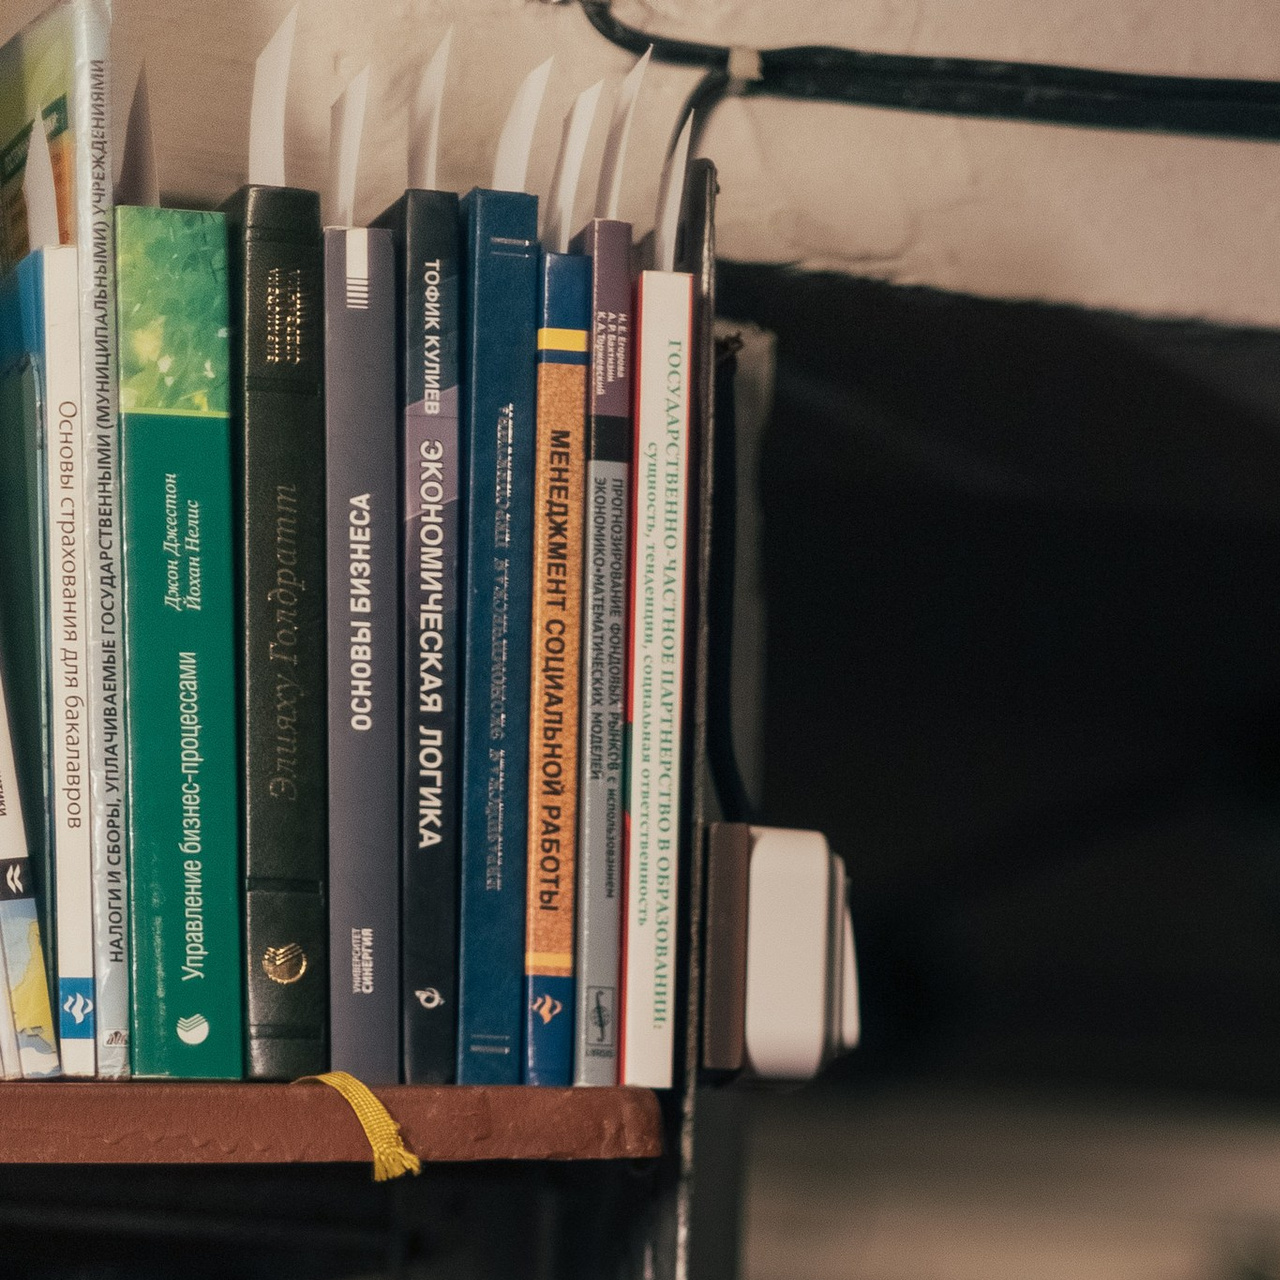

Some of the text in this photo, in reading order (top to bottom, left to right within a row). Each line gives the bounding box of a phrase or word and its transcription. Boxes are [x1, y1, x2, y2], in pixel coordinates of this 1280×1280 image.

[424, 259, 441, 414] ТОФИК КУЛИЕВ
[616, 336, 628, 378] Егорова
[90, 59, 124, 963] НАЛОГИ И СБОРЫ, УПЛАЧИВАЕМЫЕ ГОСУДАРСТВЕННЫМИ (МУНИЦИПАЛЬНЫМИ) УЧРЕЖДЕНИЯМИ
[162, 473, 182, 610] Джон Джестон
[184, 500, 202, 611] Йохан Нелис
[609, 477, 624, 617] ПРОГНОЗИРОВАНИЕ
[661, 339, 683, 664] ГОСУДАРСТВЕННО-ЧАСТНОЕ
[56, 401, 84, 829] Основы страхования для бакалавров
[267, 483, 304, 801] Элияху Голдратт
[348, 493, 373, 731] ОСНОВЫ БИЗНЕСА
[418, 439, 443, 850] ЭКОНОМИЧЕСКАЯ ЛОГИКА
[539, 428, 572, 911] МЕНЕДЖМЕНТ СОЦИАЛЬНОЙ РАБОТЫ
[608, 623, 623, 707] ФОНДОВЫХ
[638, 442, 659, 926] сущность, тенденции, социальная ответственность
[176, 652, 208, 981] Управление бизнес-процессами
[590, 712, 605, 781] МОДЕЛЕЙ
[607, 712, 621, 771] РЫНКОВ
[658, 670, 676, 833] ПАРТНЕРСТВО
[604, 788, 616, 899] использованием
[657, 838, 671, 851] В
[351, 927, 374, 994] УНИВЕРСИТЕТ СИНЕРГИЯ
